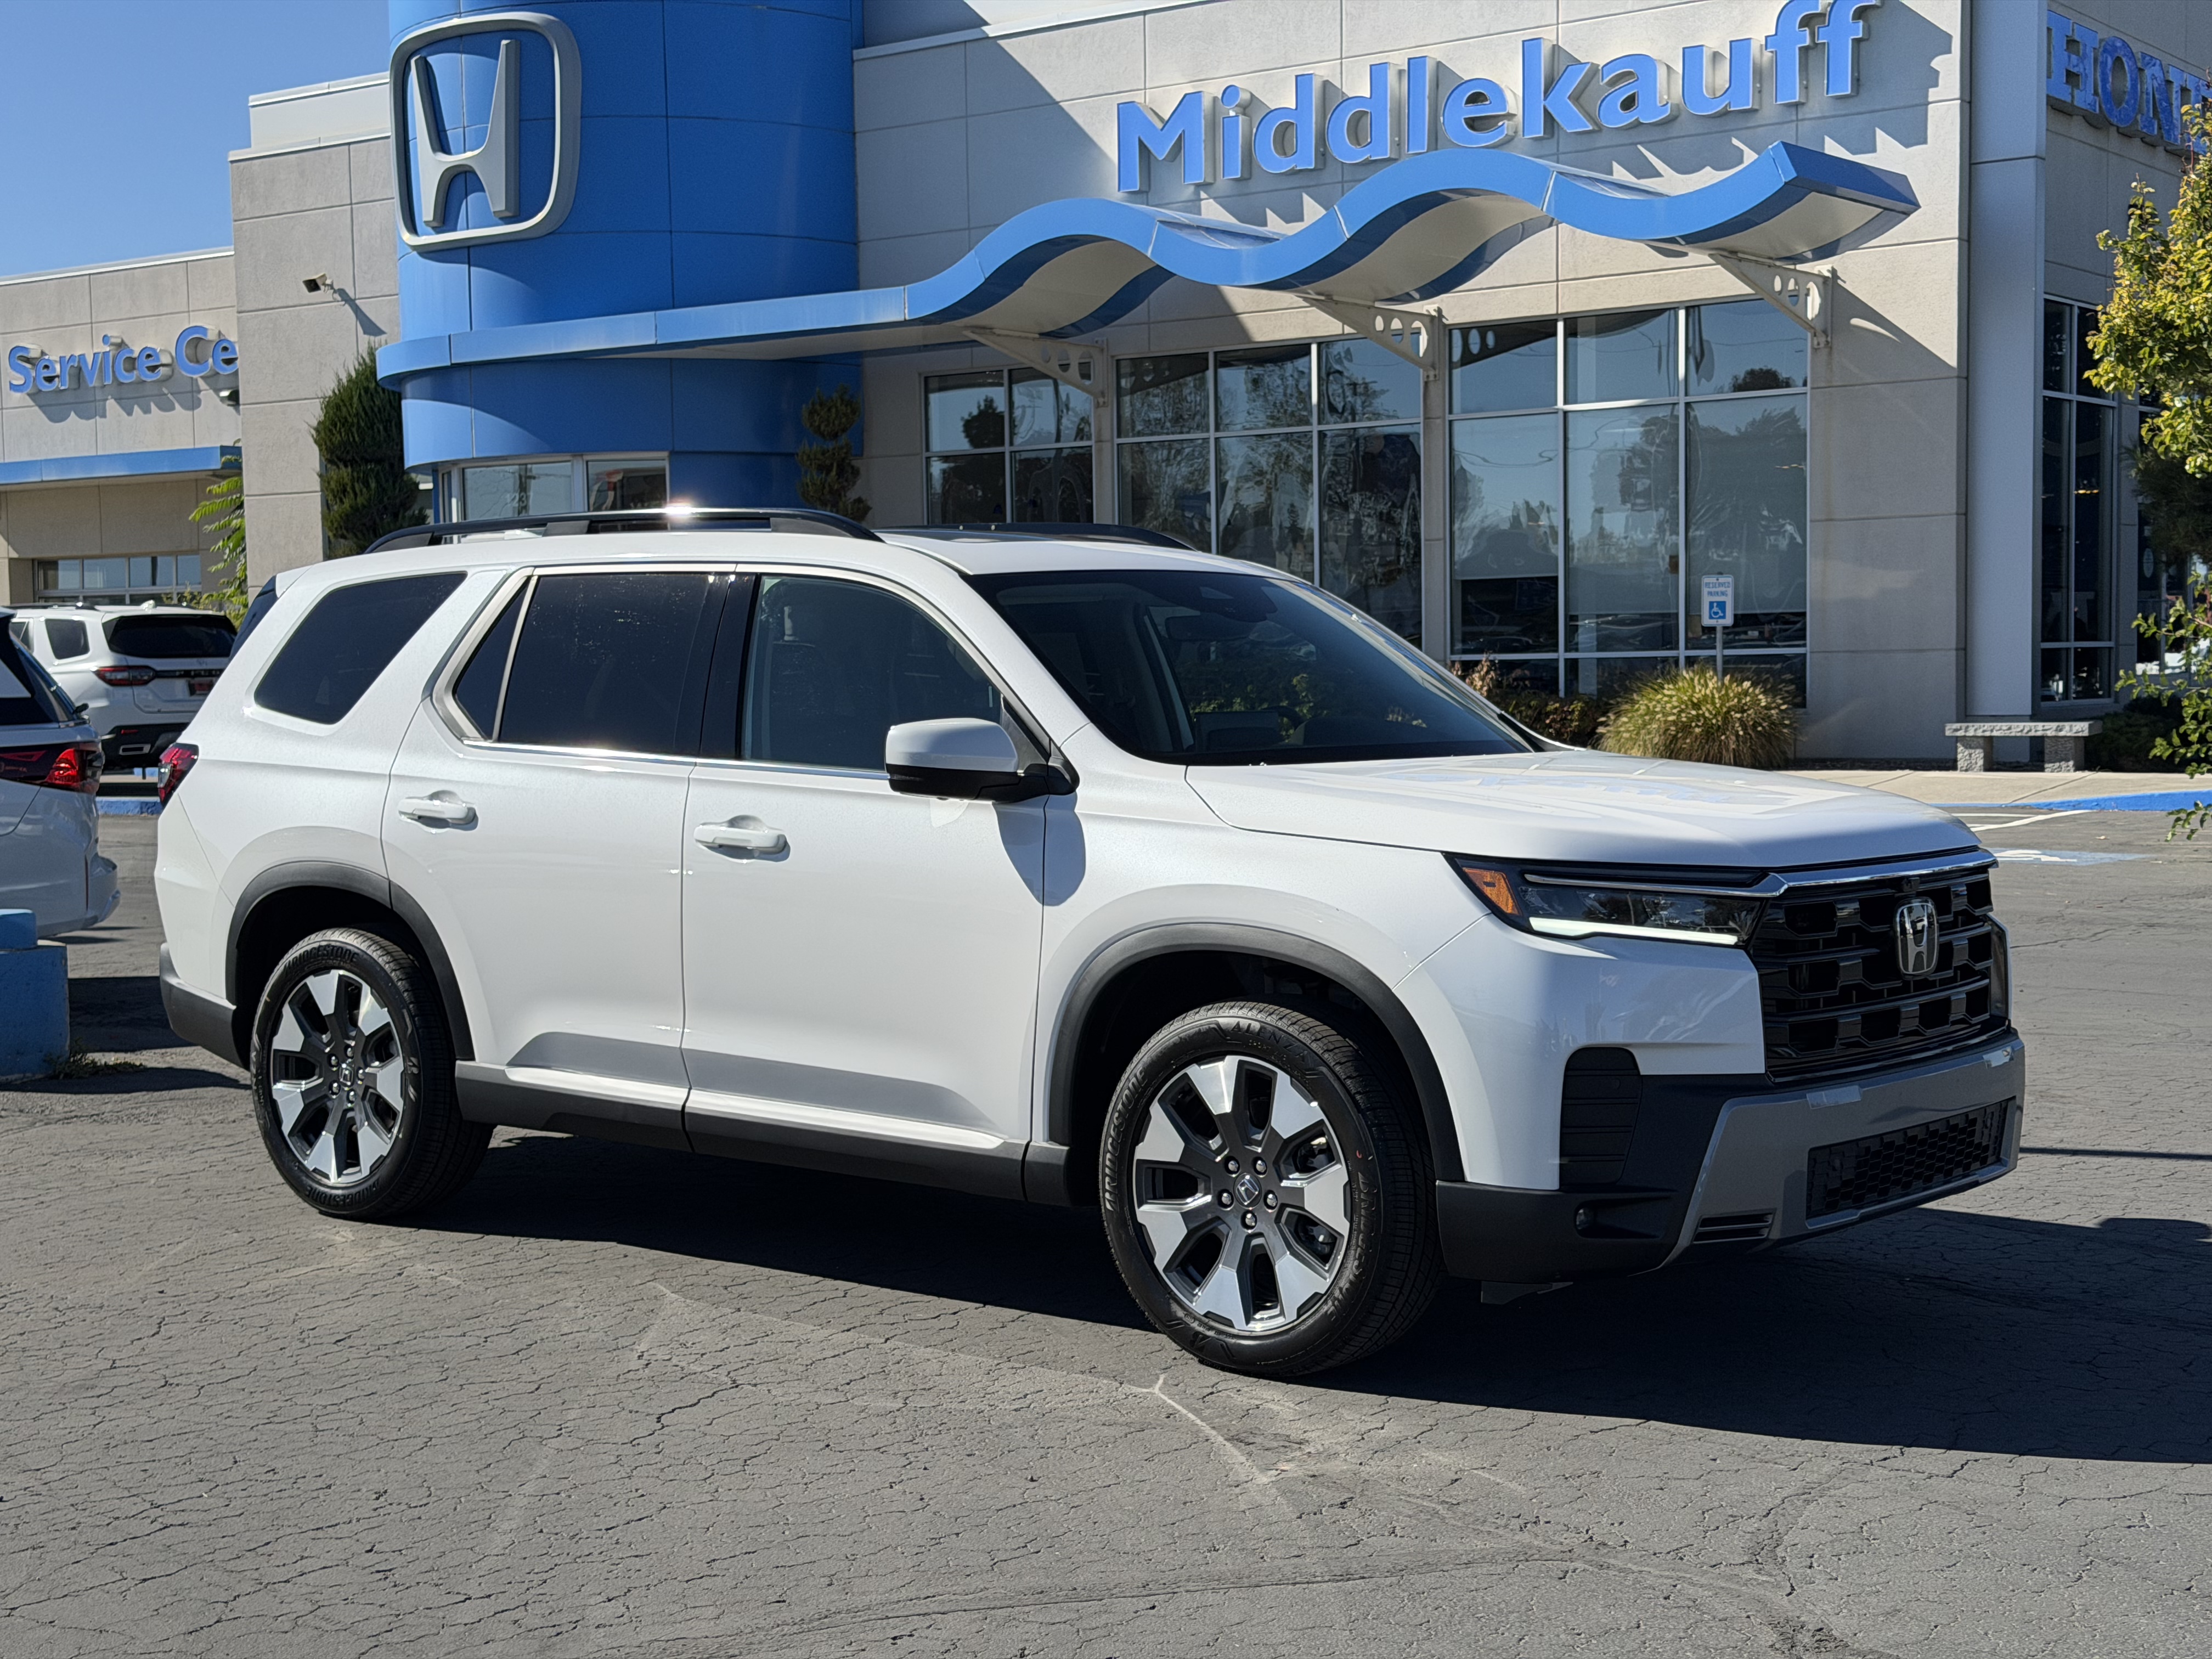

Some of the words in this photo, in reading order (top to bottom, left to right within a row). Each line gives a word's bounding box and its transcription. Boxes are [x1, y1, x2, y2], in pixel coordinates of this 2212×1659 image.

[1117, 0, 1876, 194] Middlekauff
[8, 334, 162, 393] Service
[175, 325, 239, 377] Ce
[1104, 1066, 1148, 1212] BRIDGESTONE
